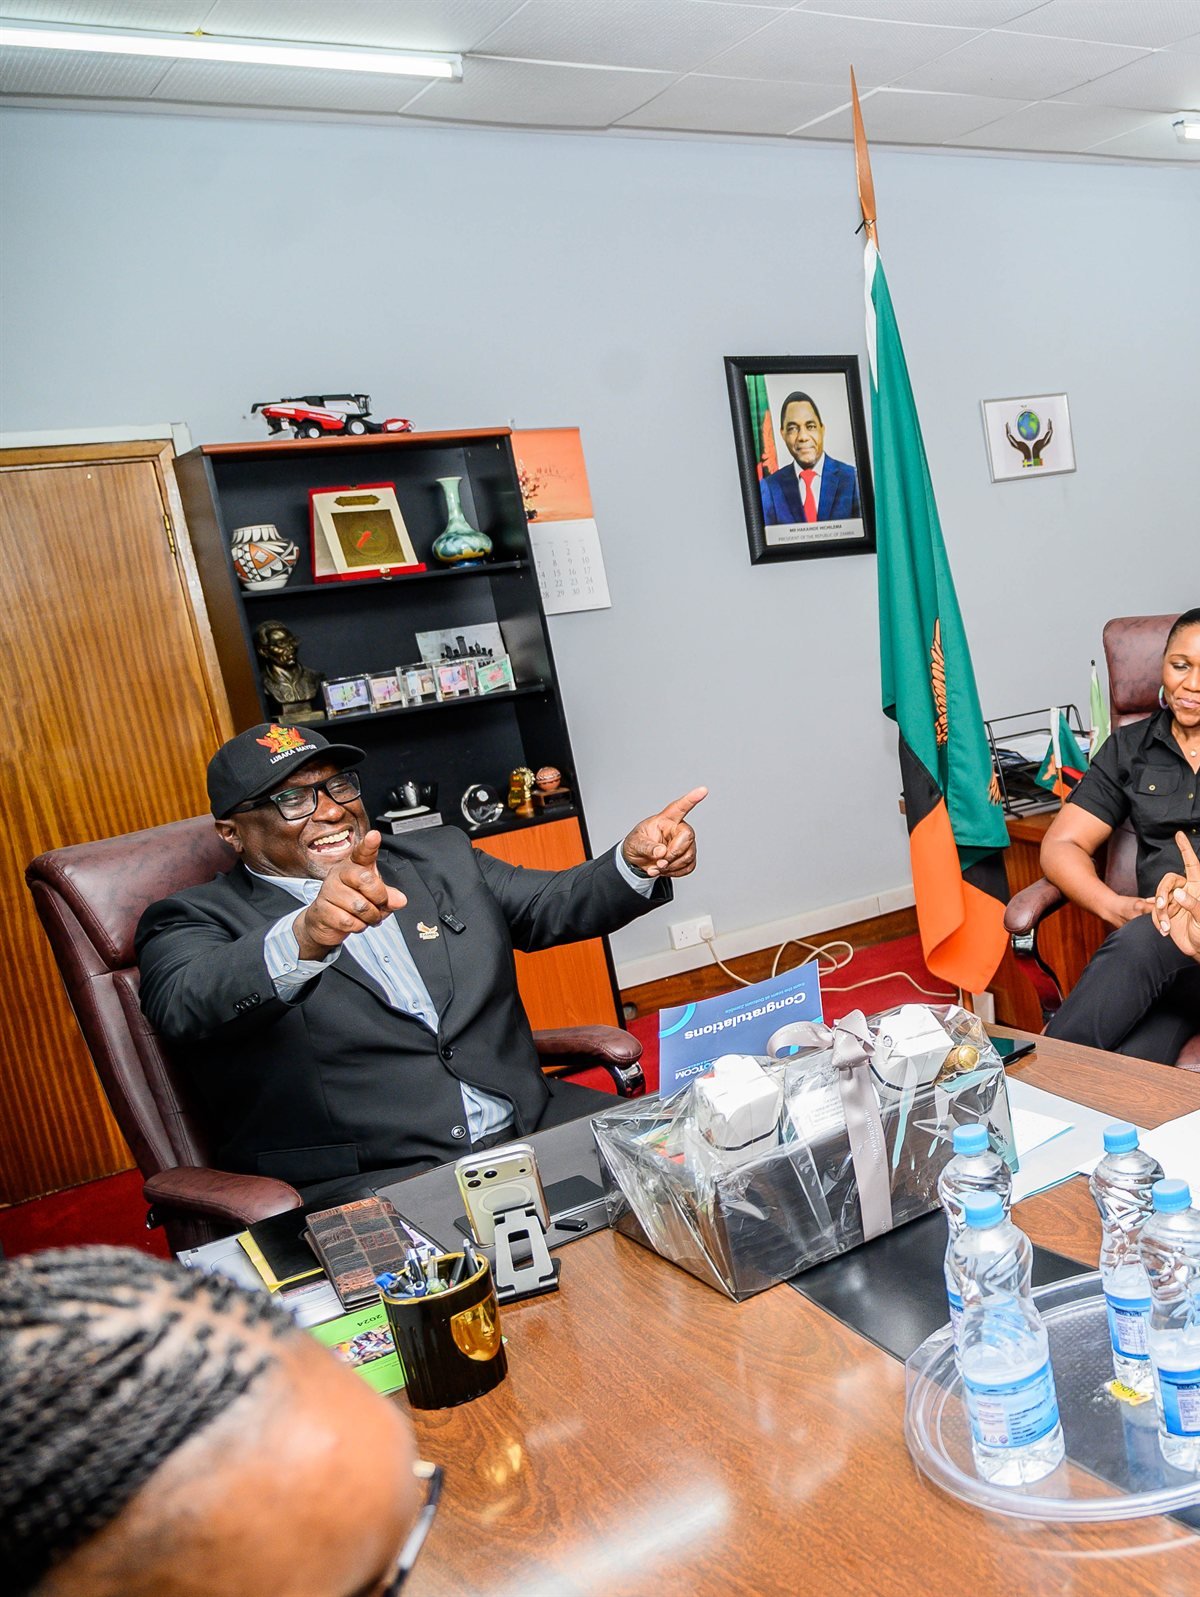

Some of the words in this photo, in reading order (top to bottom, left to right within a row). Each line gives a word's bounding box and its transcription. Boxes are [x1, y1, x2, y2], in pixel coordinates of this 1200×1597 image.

[269, 749, 296, 765] LUSAKA
[684, 992, 807, 1040] Congratulations
[356, 1313, 383, 1327] 2024
